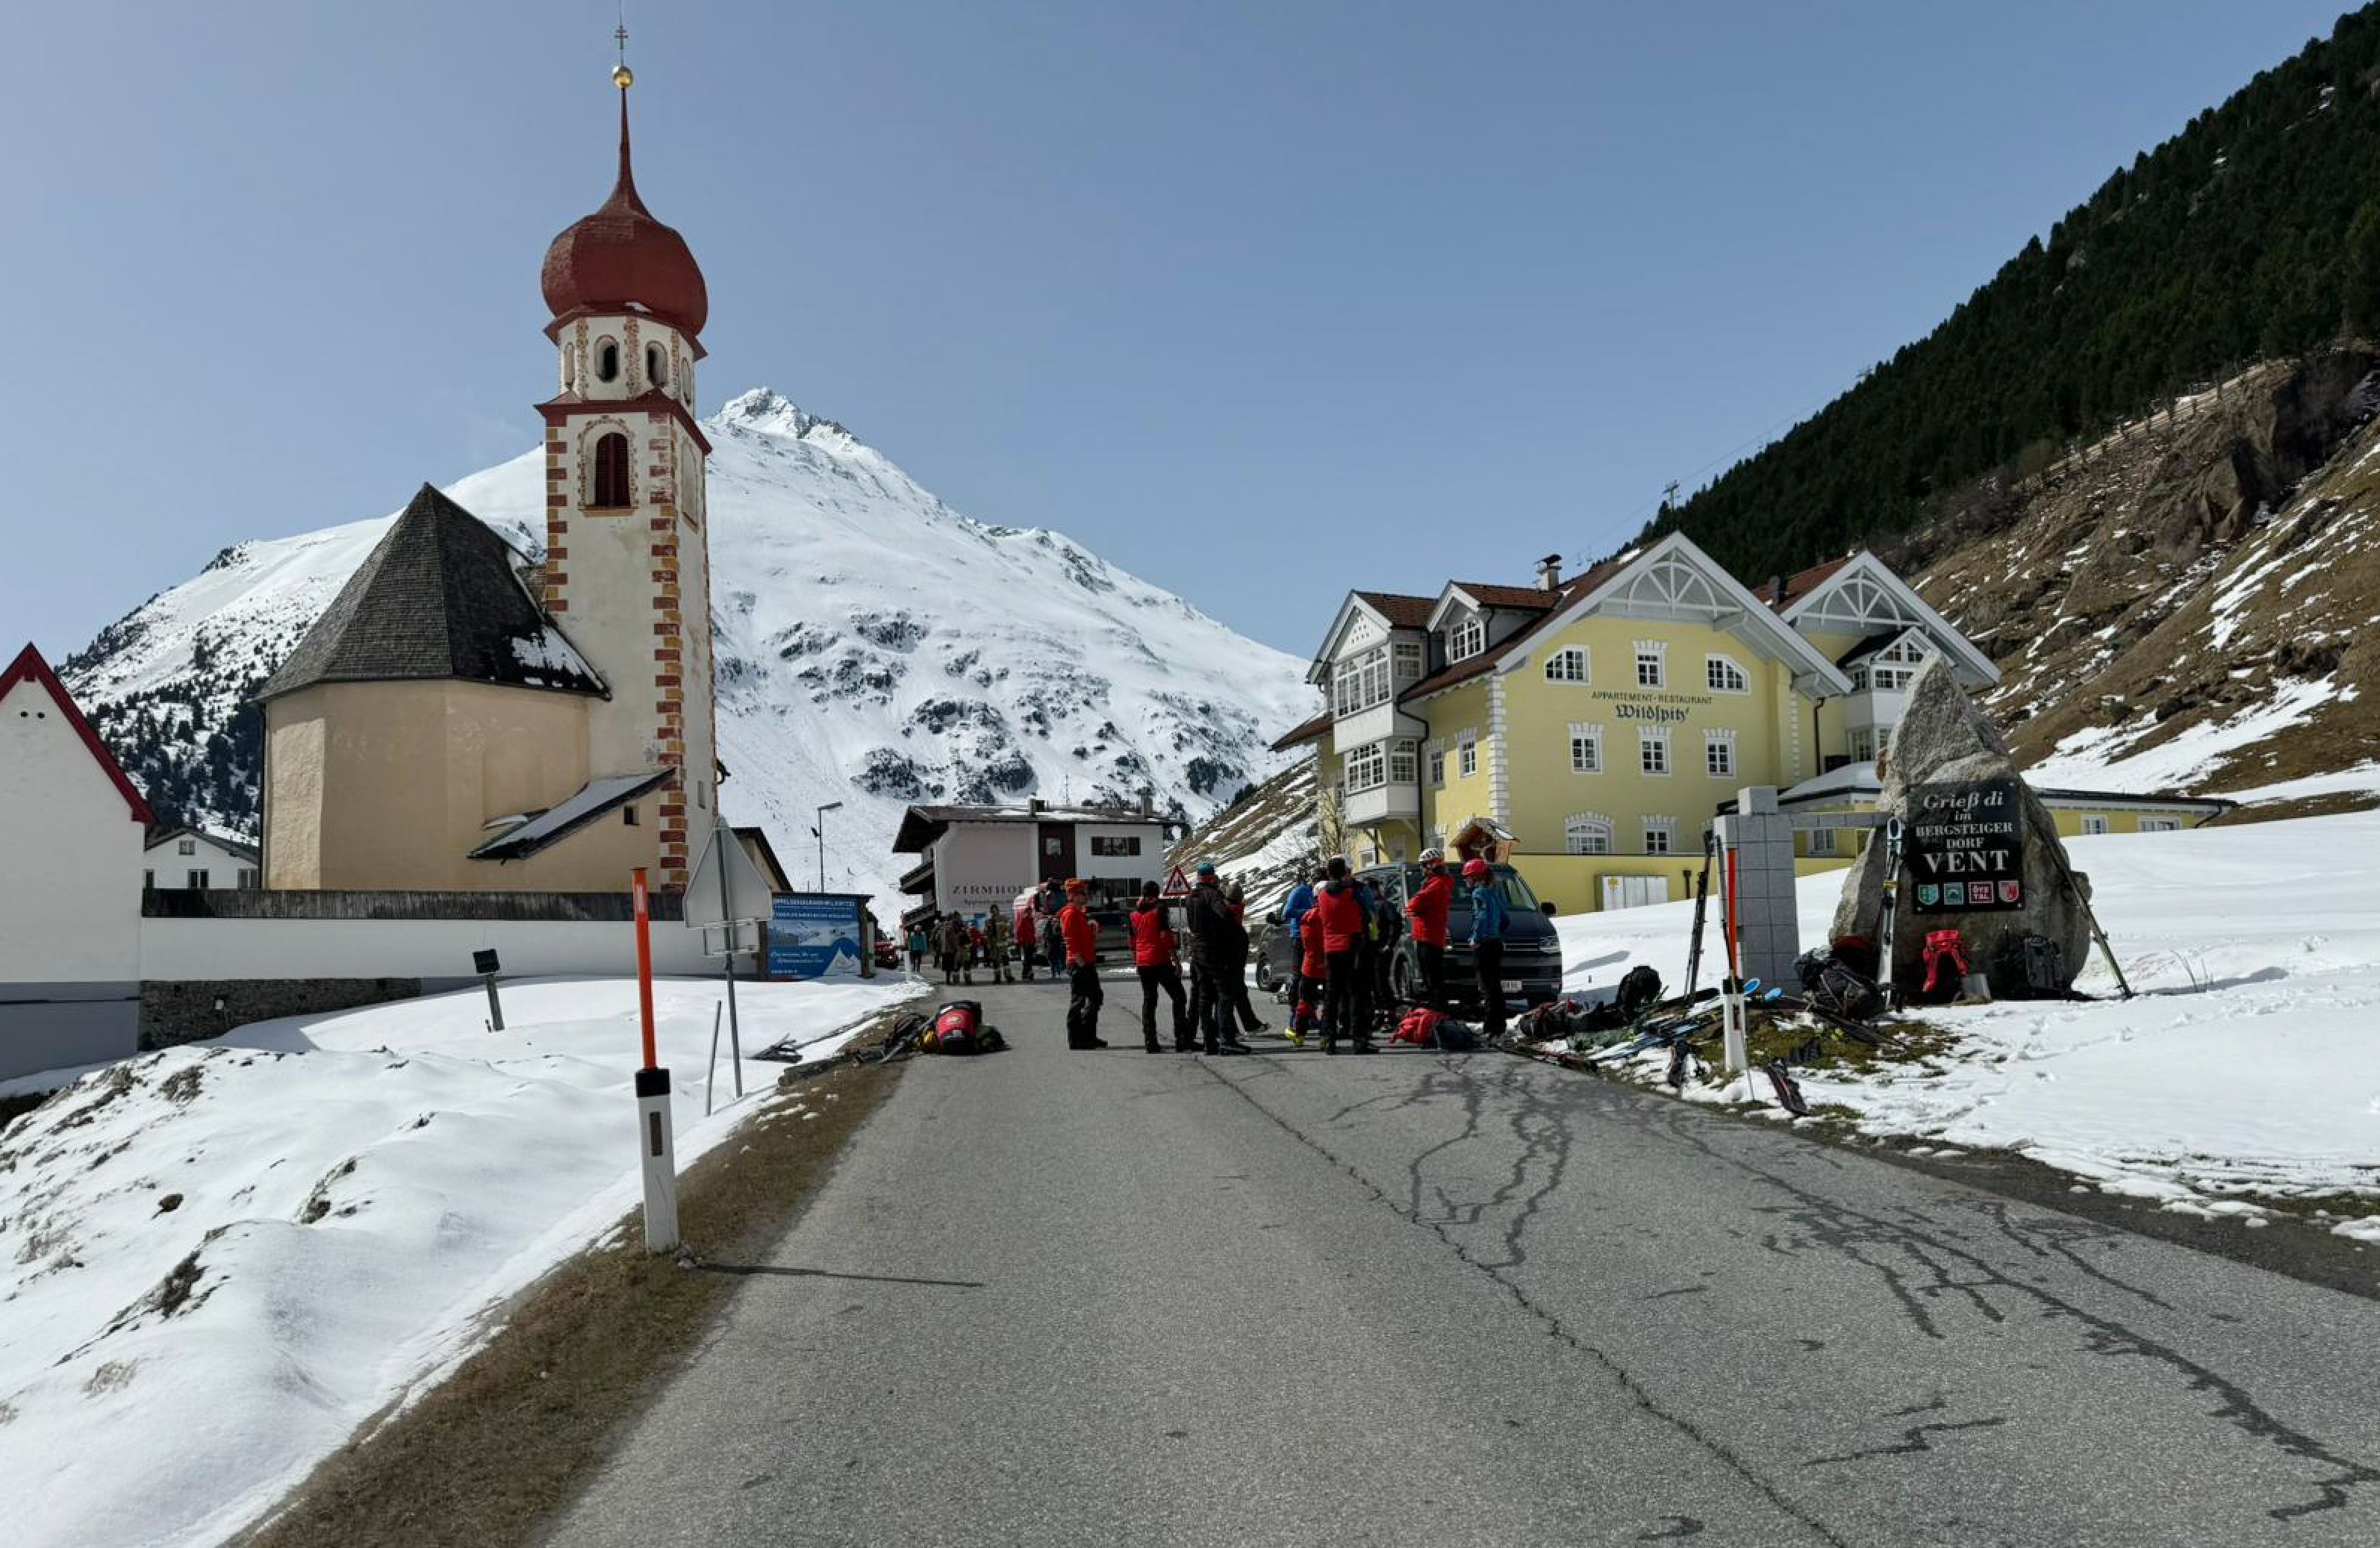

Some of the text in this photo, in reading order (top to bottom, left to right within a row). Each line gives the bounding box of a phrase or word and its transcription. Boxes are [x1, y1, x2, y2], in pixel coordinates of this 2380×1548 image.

[1923, 790, 2004, 812] Grieß di
[1954, 811, 1972, 822] im
[1915, 822, 2013, 837] BERGSTEIGER
[1946, 837, 1985, 849] DORF
[1922, 849, 2009, 873] VENT
